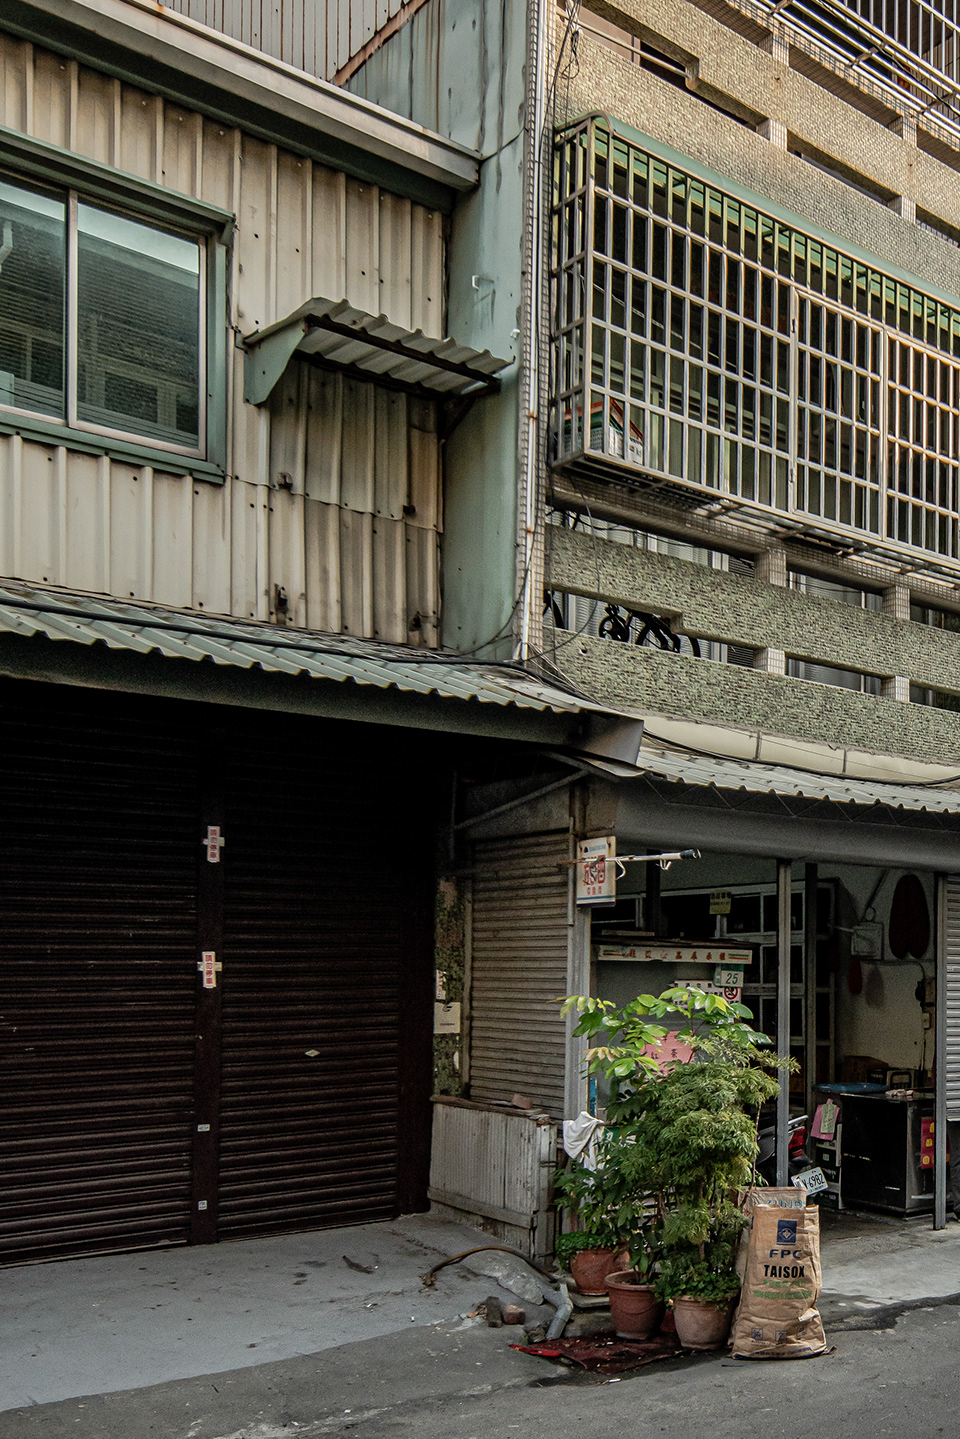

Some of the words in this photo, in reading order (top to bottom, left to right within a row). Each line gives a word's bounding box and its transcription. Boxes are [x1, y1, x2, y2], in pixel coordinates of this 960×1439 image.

[725, 972, 739, 985] 25
[769, 1248, 803, 1259] FPC
[764, 1264, 805, 1279] TAISOX
